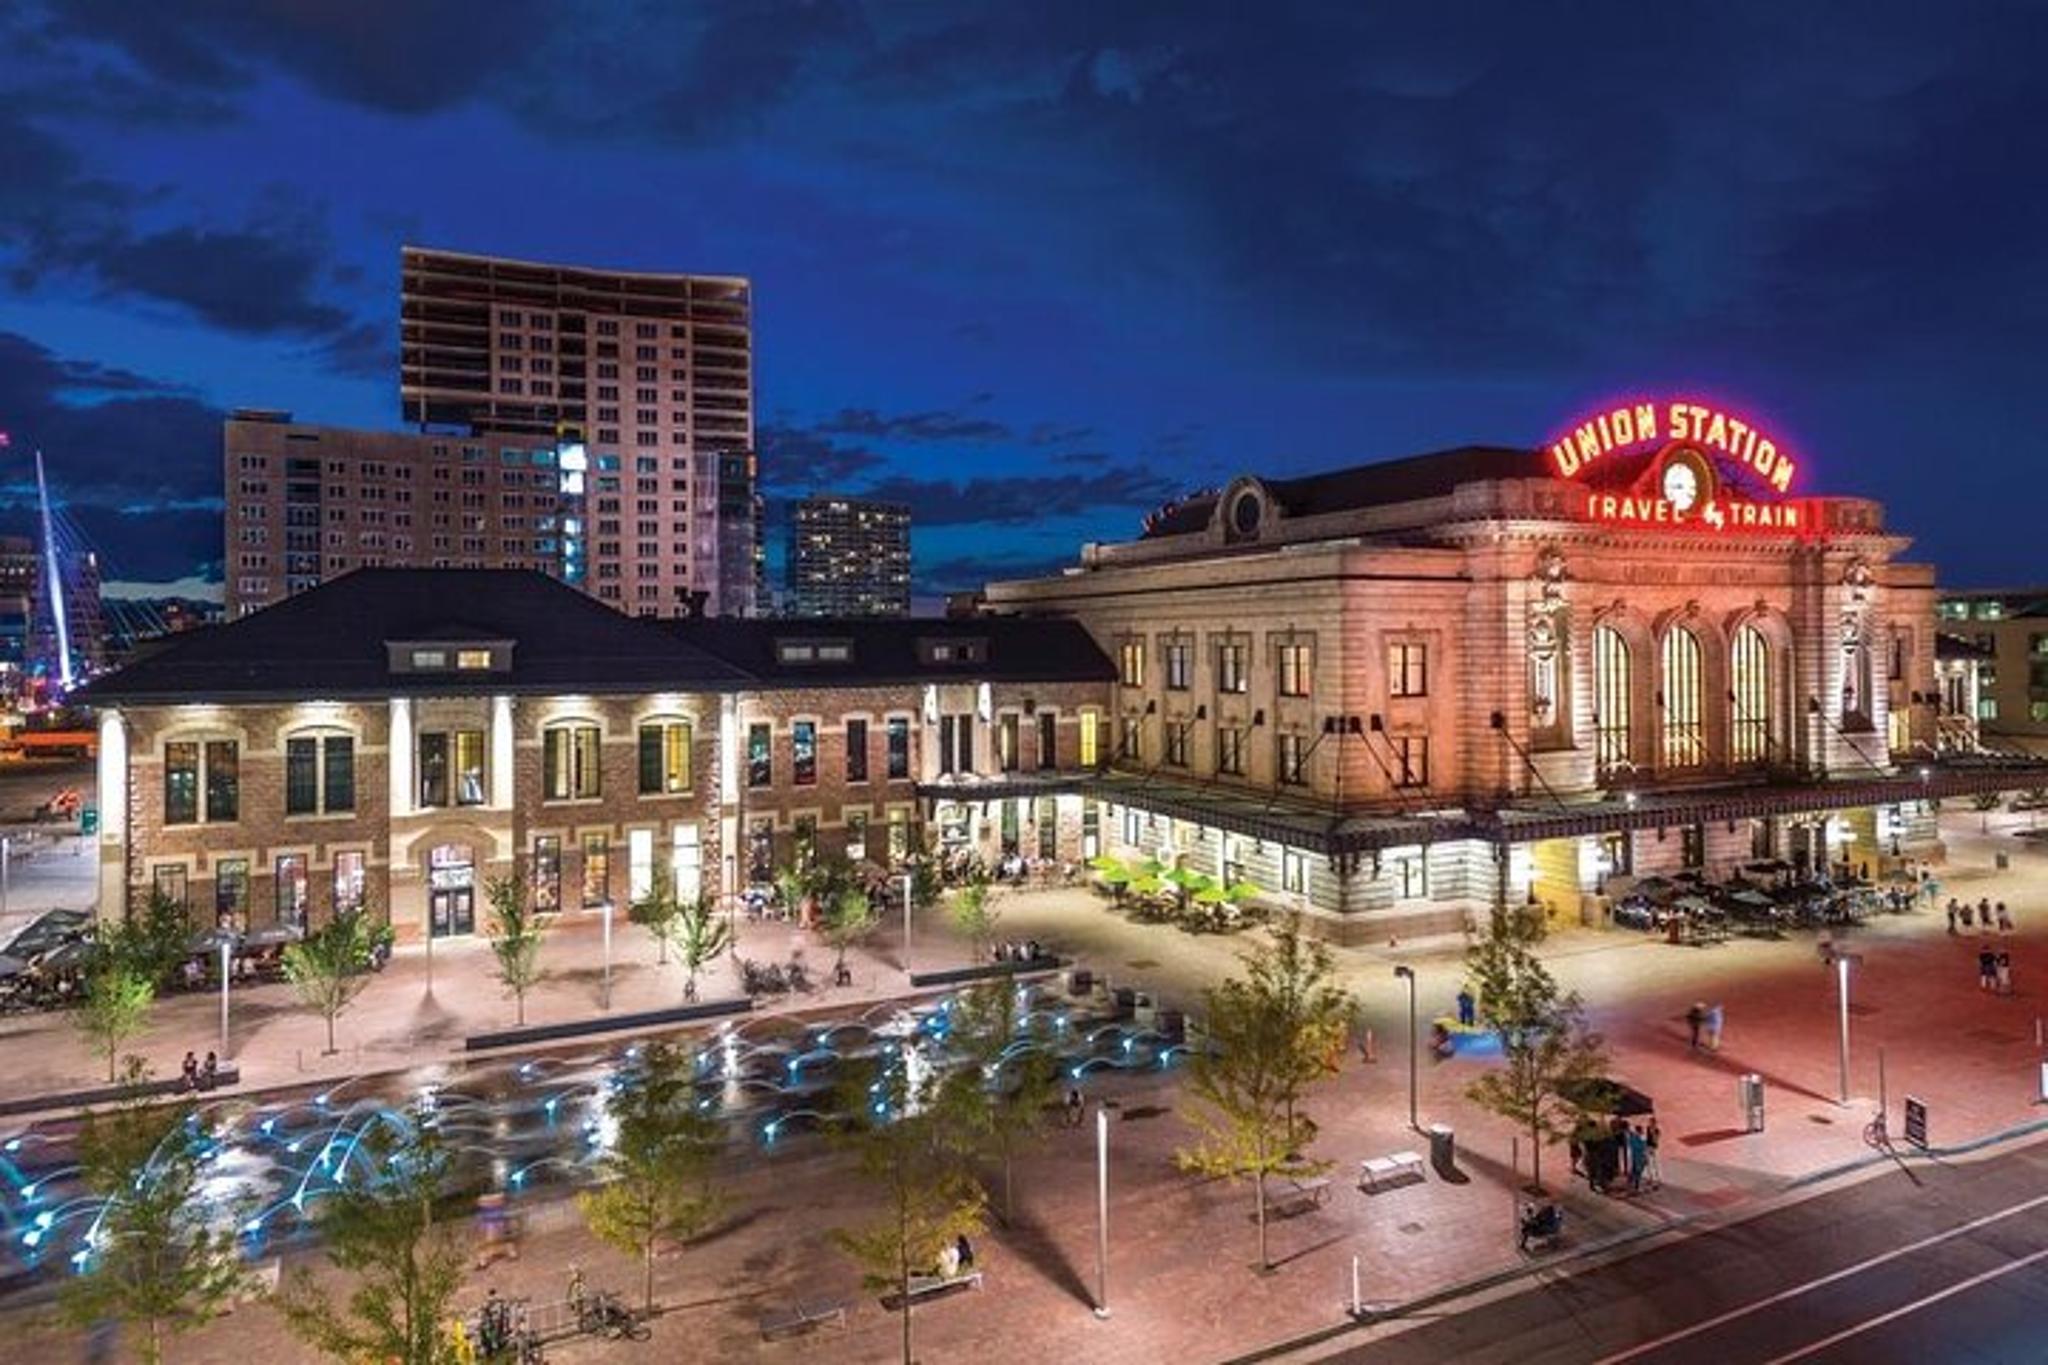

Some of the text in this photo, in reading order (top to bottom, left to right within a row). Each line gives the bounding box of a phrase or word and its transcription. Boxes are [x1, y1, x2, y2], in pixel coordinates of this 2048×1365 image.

[1553, 403, 1794, 492] UNION STATION
[1588, 495, 1684, 523] TRAVEL
[1731, 503, 1797, 527] TRAIN
